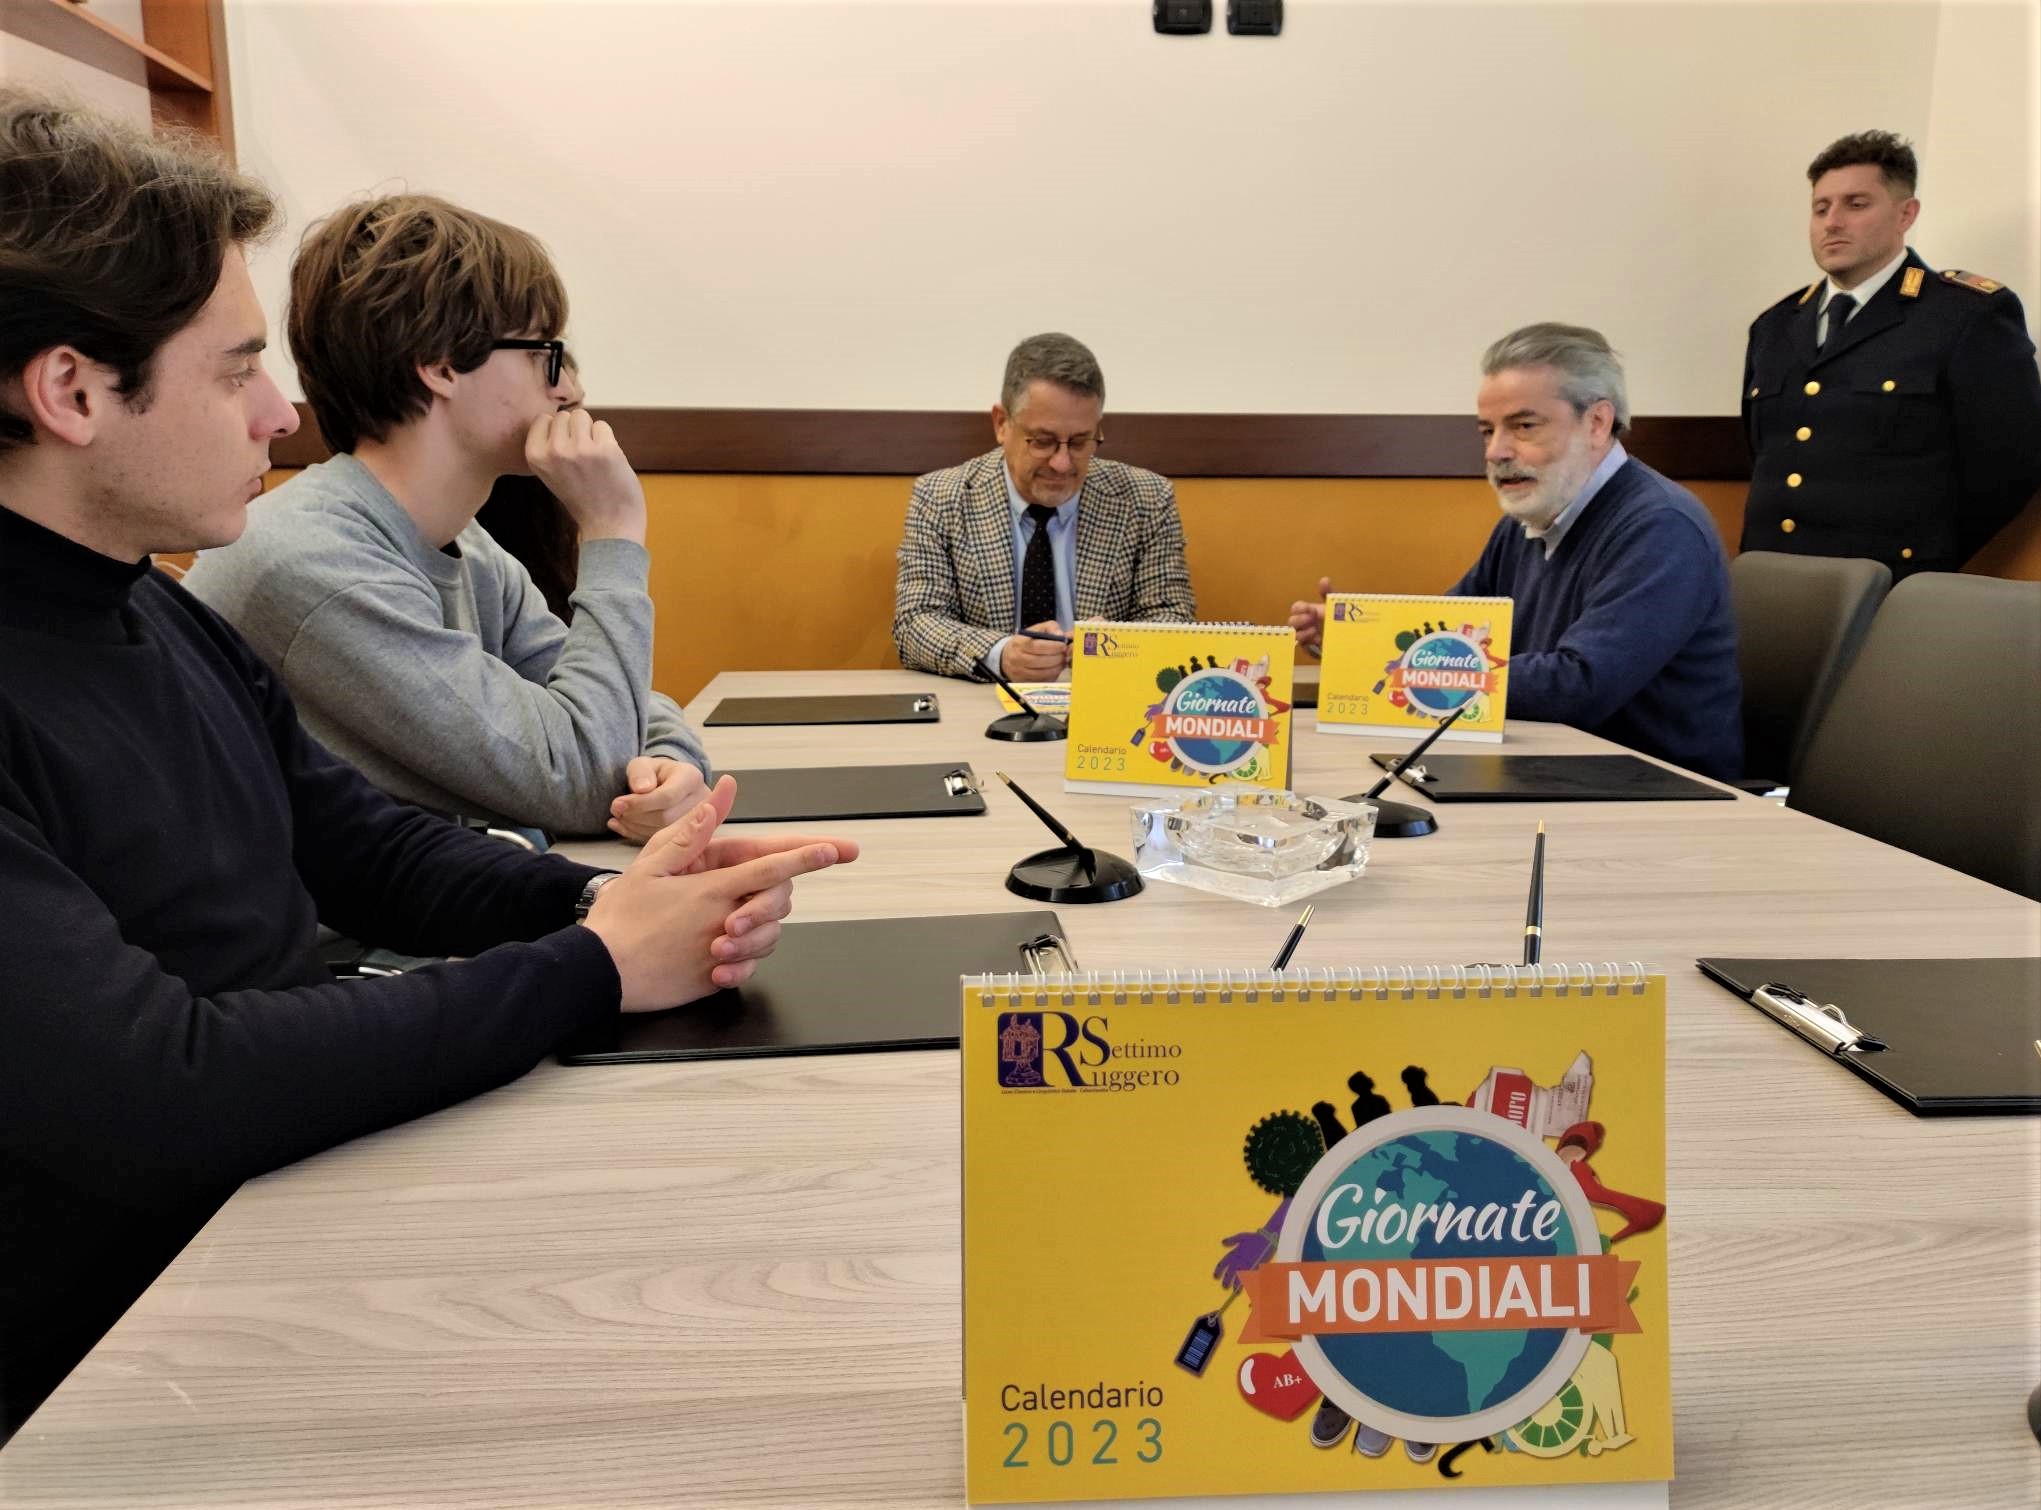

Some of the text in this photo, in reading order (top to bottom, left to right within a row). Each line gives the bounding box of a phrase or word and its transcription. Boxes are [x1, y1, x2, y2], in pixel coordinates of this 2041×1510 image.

[1411, 648, 1480, 668] Giornate
[1401, 670, 1486, 689] MONDIALI
[1176, 690, 1257, 713] Giornate
[1327, 702, 1369, 715] 2023
[1165, 716, 1265, 738] MONDIALI
[1077, 743, 1127, 755] Calendario
[1077, 755, 1126, 771] 2023
[1316, 1183, 1561, 1249] Giornate
[1288, 1263, 1590, 1324] MONDIALI
[1273, 1373, 1303, 1389] AB+
[1001, 1380, 1164, 1412] Calendario
[1003, 1417, 1163, 1468] 2023
